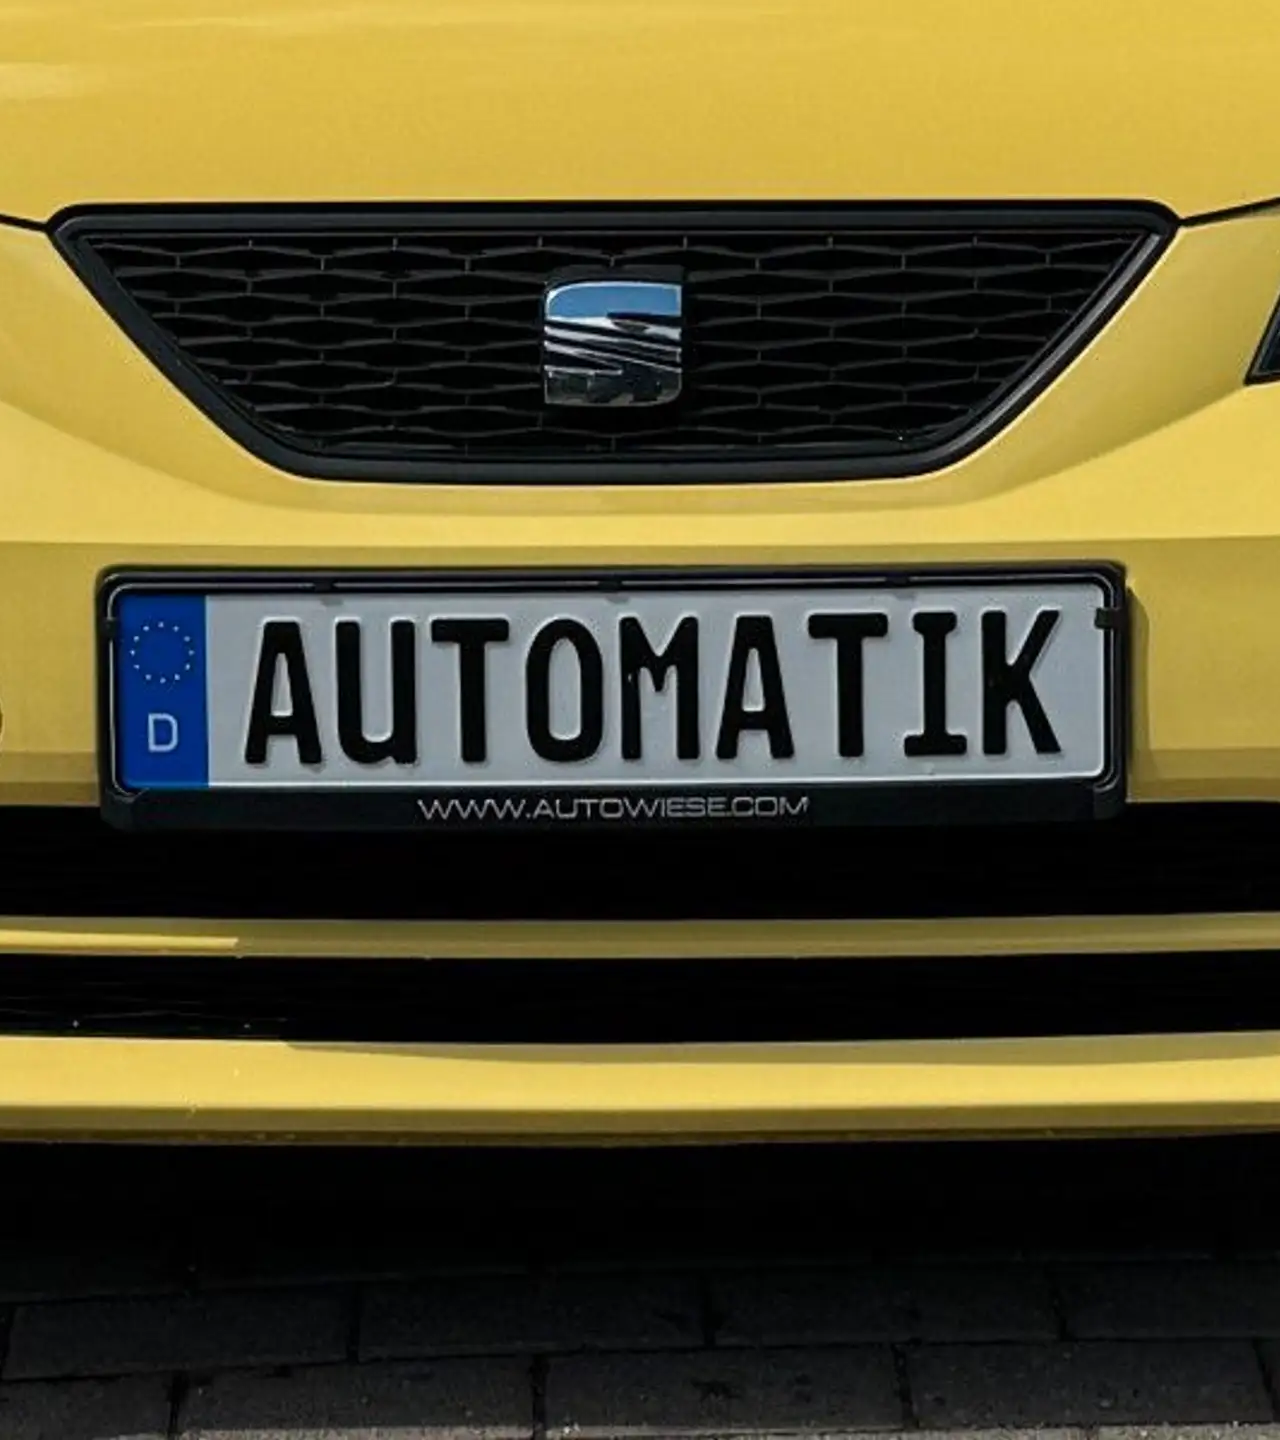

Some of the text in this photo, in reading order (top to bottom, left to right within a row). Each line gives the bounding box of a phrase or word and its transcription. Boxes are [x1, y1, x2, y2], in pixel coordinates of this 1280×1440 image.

[147, 609, 1063, 767] D AUTOMATIK
[417, 796, 810, 821] WWW.AUTOWIESE.COM
